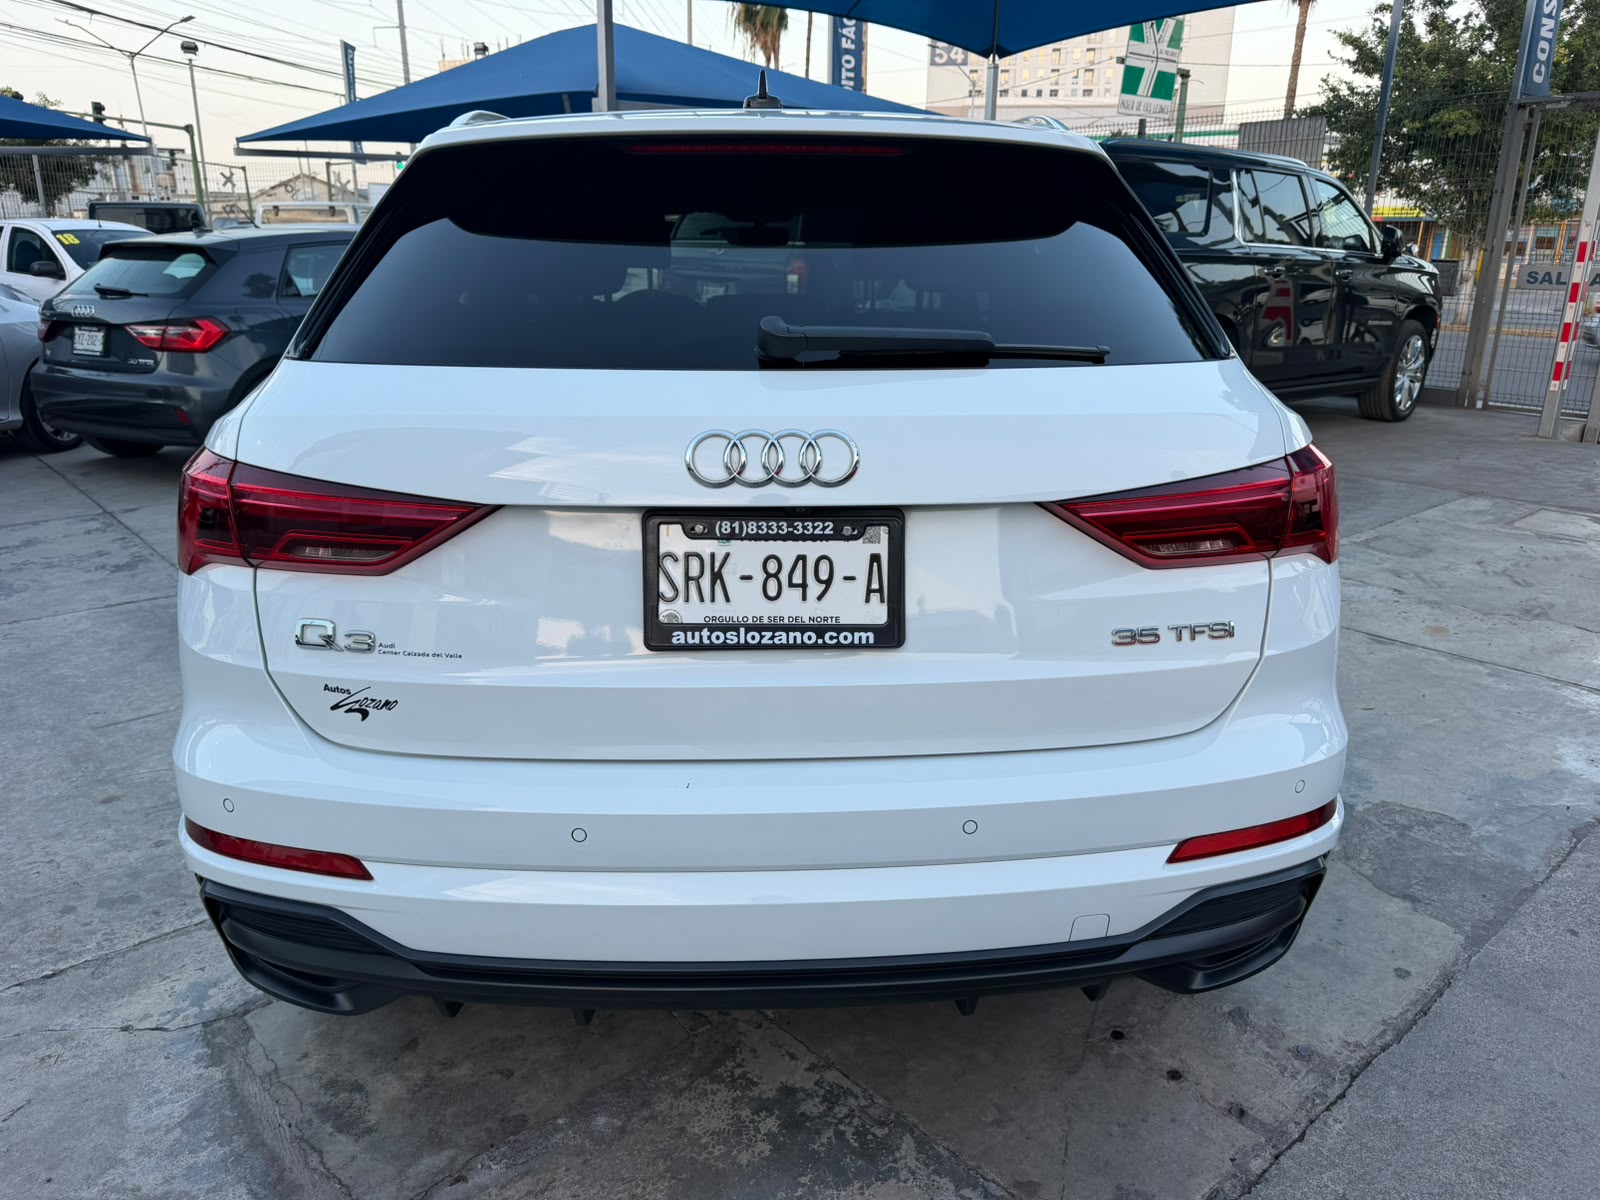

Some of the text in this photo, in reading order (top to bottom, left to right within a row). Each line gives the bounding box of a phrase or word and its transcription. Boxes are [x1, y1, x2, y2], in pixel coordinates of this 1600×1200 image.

[715, 521, 834, 537] (81)8333-3322
[658, 551, 886, 604] SRK-849-A
[703, 615, 841, 624] ORGULLO DE SER DEL NORTE
[295, 617, 377, 654] Q3
[671, 627, 875, 645] autoslozano.com
[1111, 627, 1161, 647] 35
[402, 650, 430, 658] Calzada
[323, 683, 352, 696] Autos
[330, 686, 399, 722] Lozano
